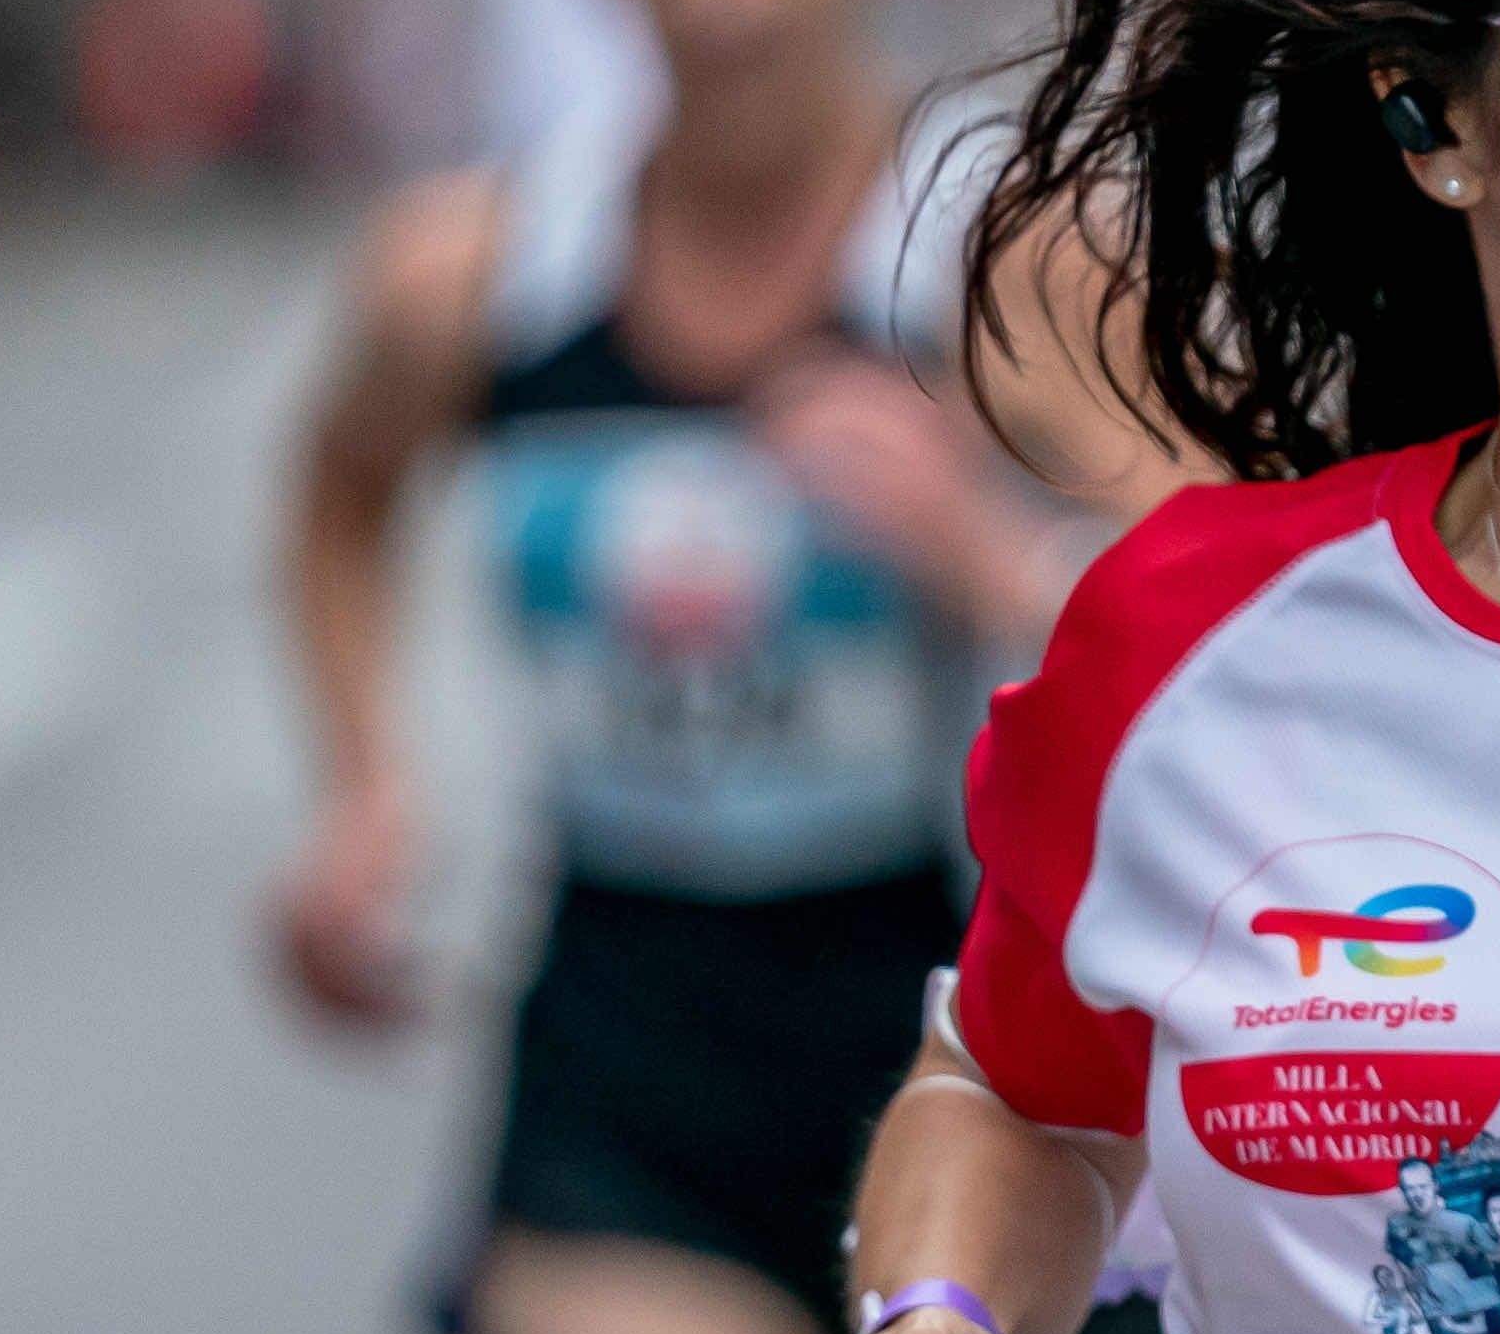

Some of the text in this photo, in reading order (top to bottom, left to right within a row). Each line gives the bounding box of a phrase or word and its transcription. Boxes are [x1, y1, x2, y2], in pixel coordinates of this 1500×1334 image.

[1233, 995, 1457, 1028] TotalEnergies
[1273, 1064, 1382, 1091] MILLA
[1235, 1133, 1431, 1164] DE MADRID
